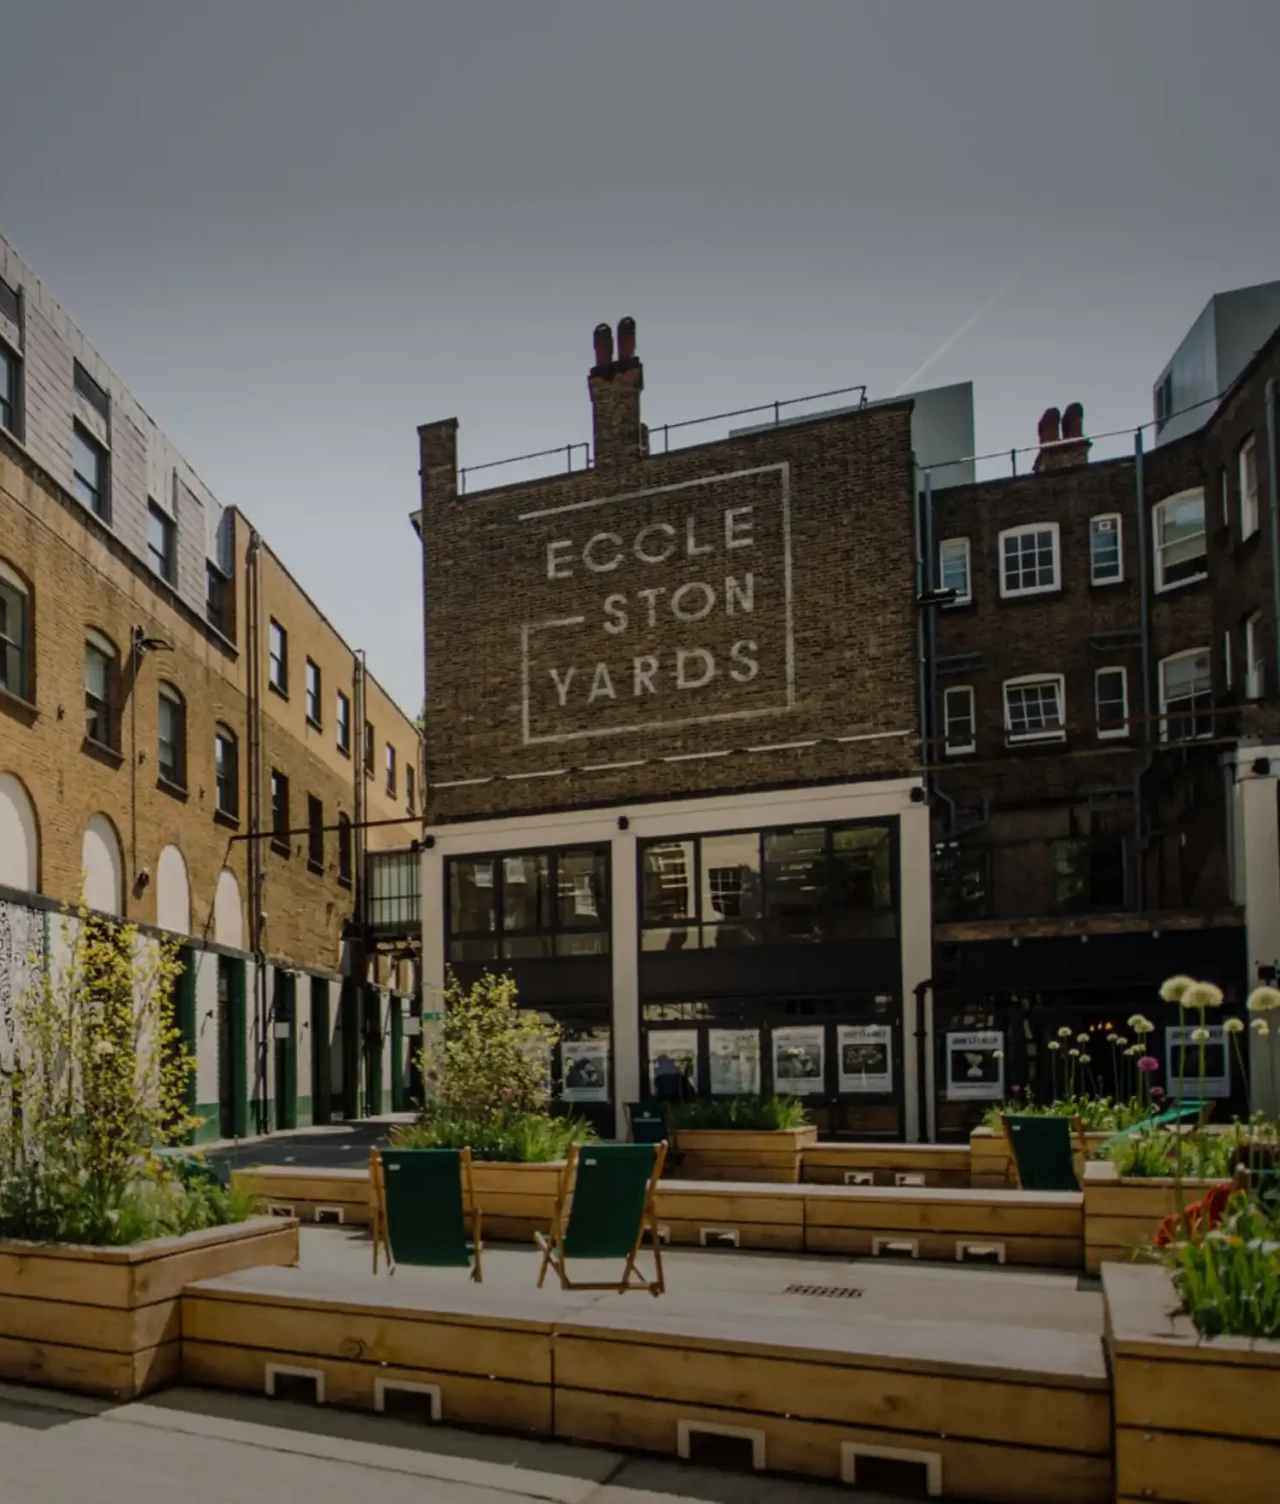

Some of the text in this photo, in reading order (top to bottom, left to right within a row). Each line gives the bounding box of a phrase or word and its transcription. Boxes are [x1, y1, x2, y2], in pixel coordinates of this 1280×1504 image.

[546, 506, 754, 580] ECCLE
[603, 572, 755, 634] STON
[549, 640, 759, 706] YARDS
